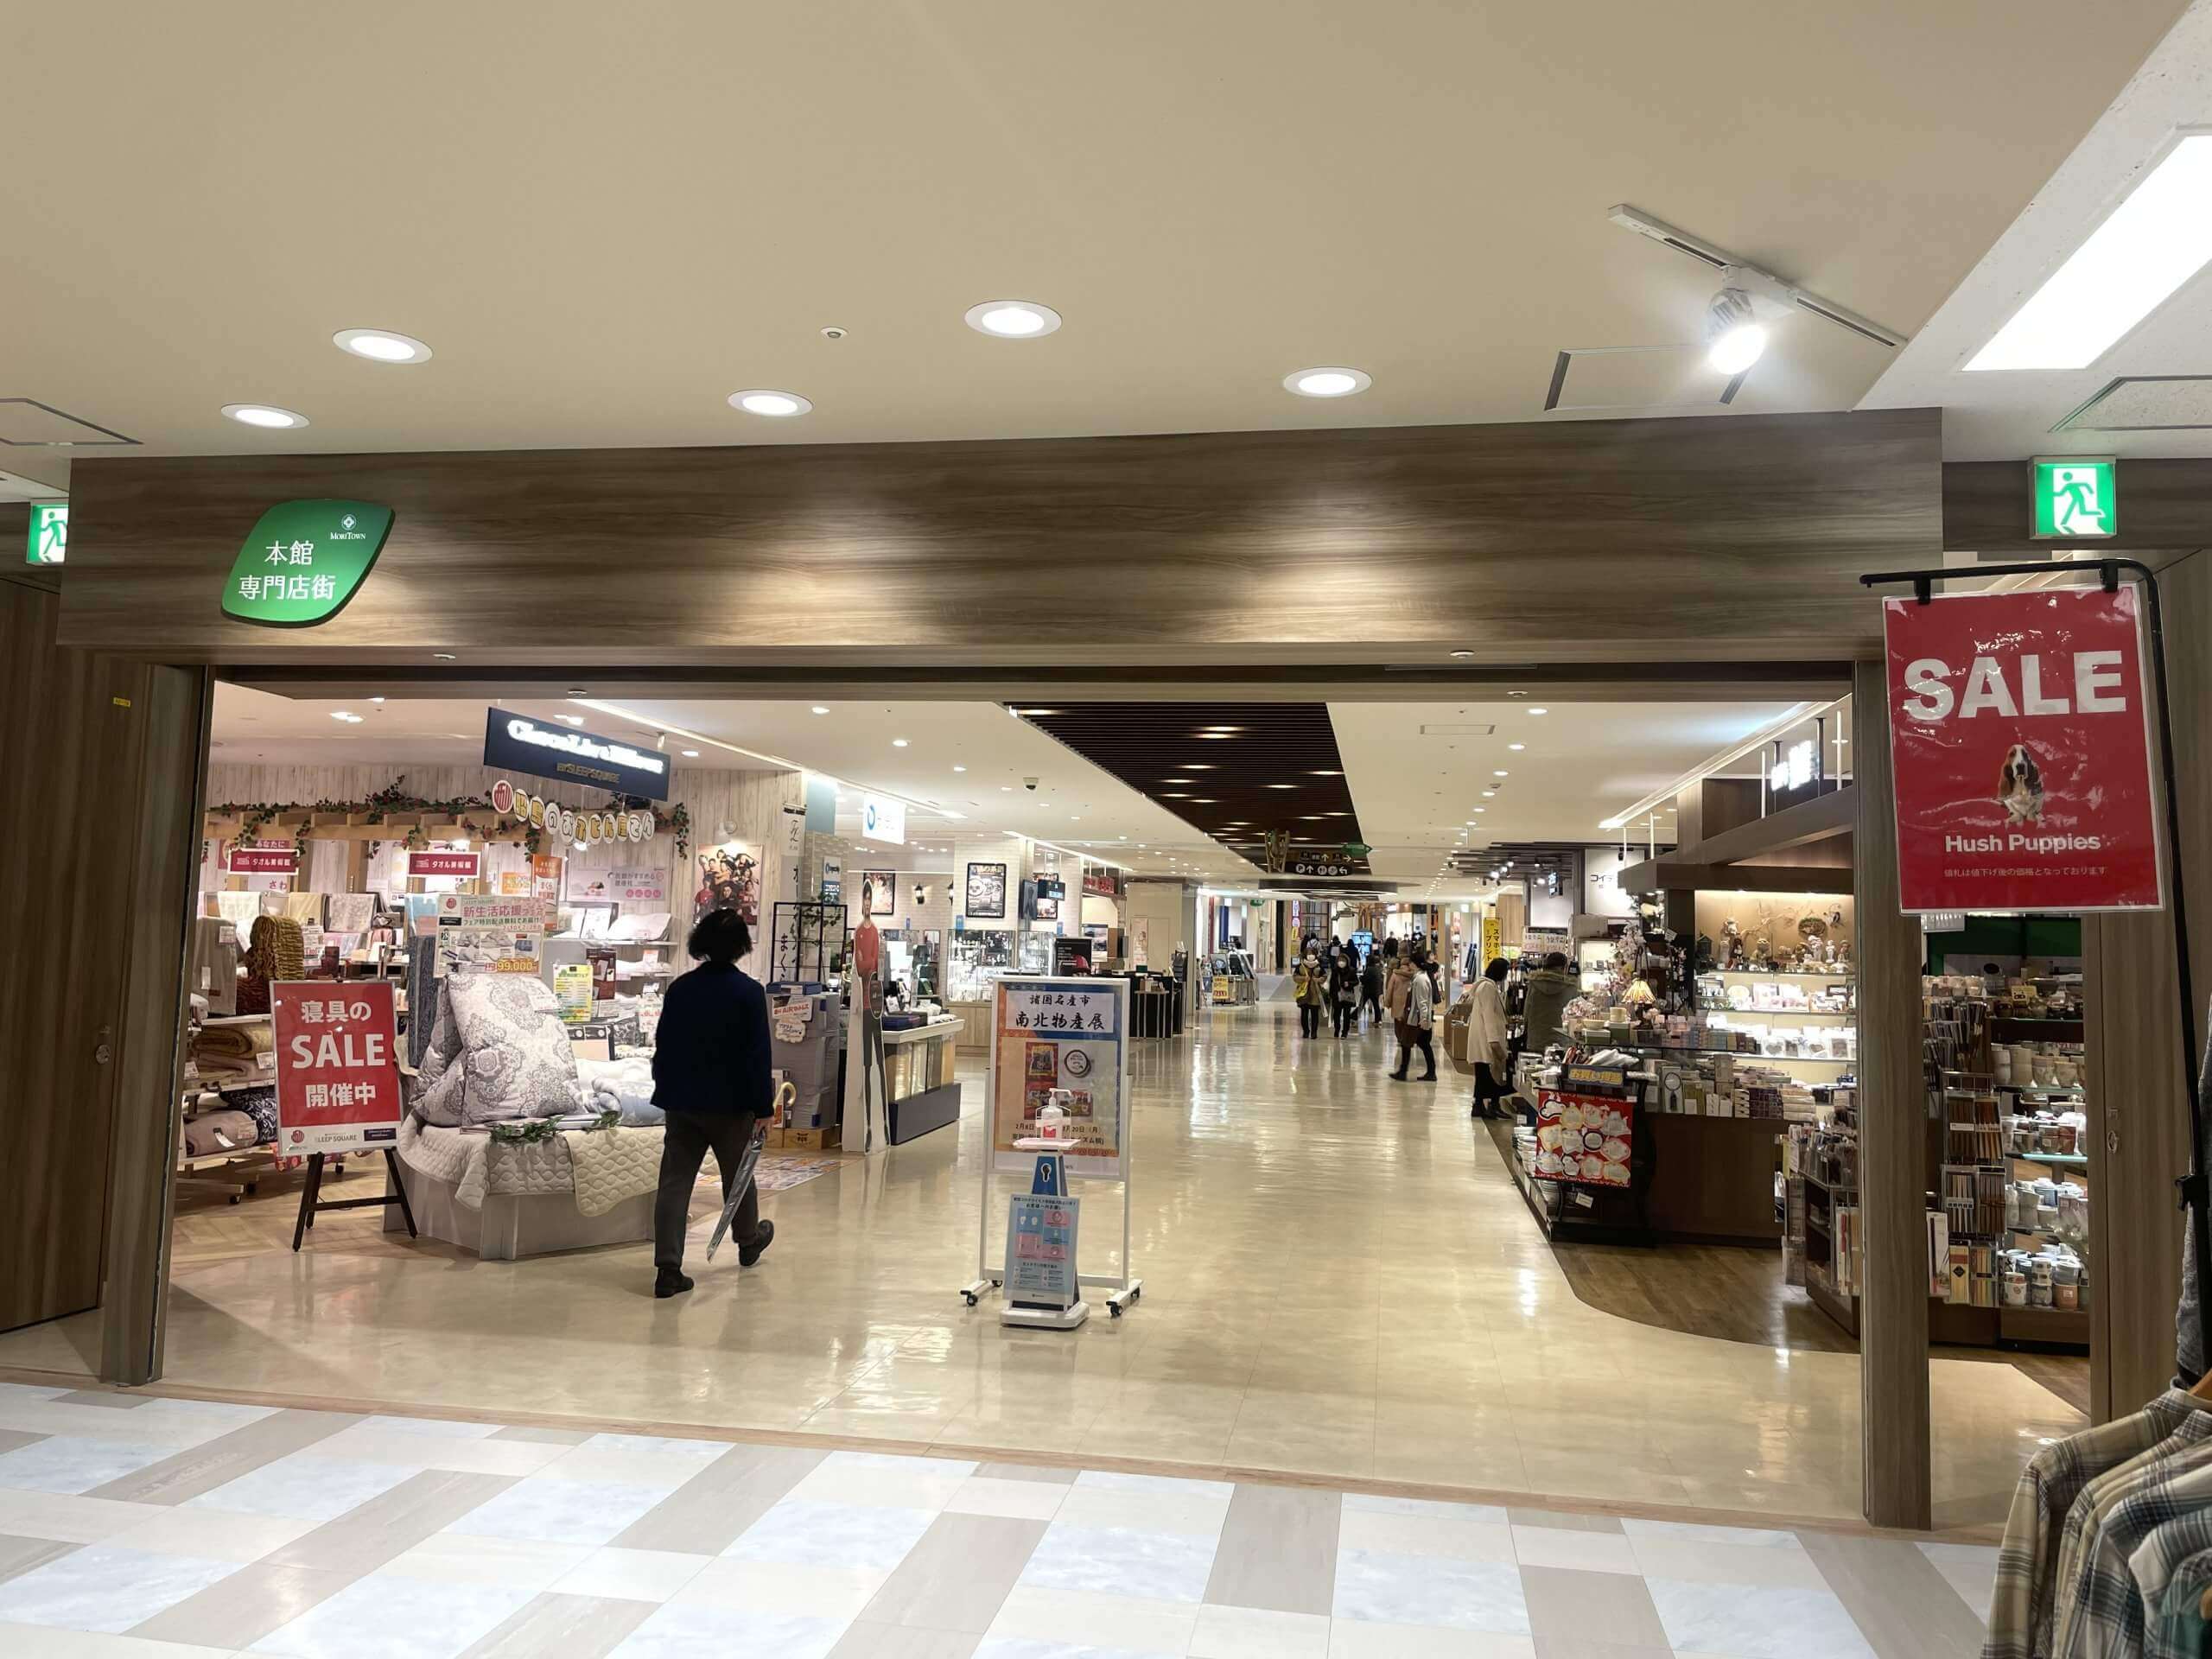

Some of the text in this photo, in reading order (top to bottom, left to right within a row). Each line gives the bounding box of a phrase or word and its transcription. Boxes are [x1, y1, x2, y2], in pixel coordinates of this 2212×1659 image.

[264, 540, 315, 566] 本館
[238, 575, 335, 601] 専門店街
[1903, 651, 2127, 721] SALE
[515, 792, 652, 843] 昭島のおふとん屋さん
[1945, 833, 2101, 855] Hush Puppies
[301, 1000, 372, 1024] 寝具の
[1029, 994, 1092, 1007] 諸国名産市
[1015, 1010, 1105, 1031] 南北物産展
[290, 1033, 386, 1070] SALE
[305, 1082, 377, 1108] 開催中
